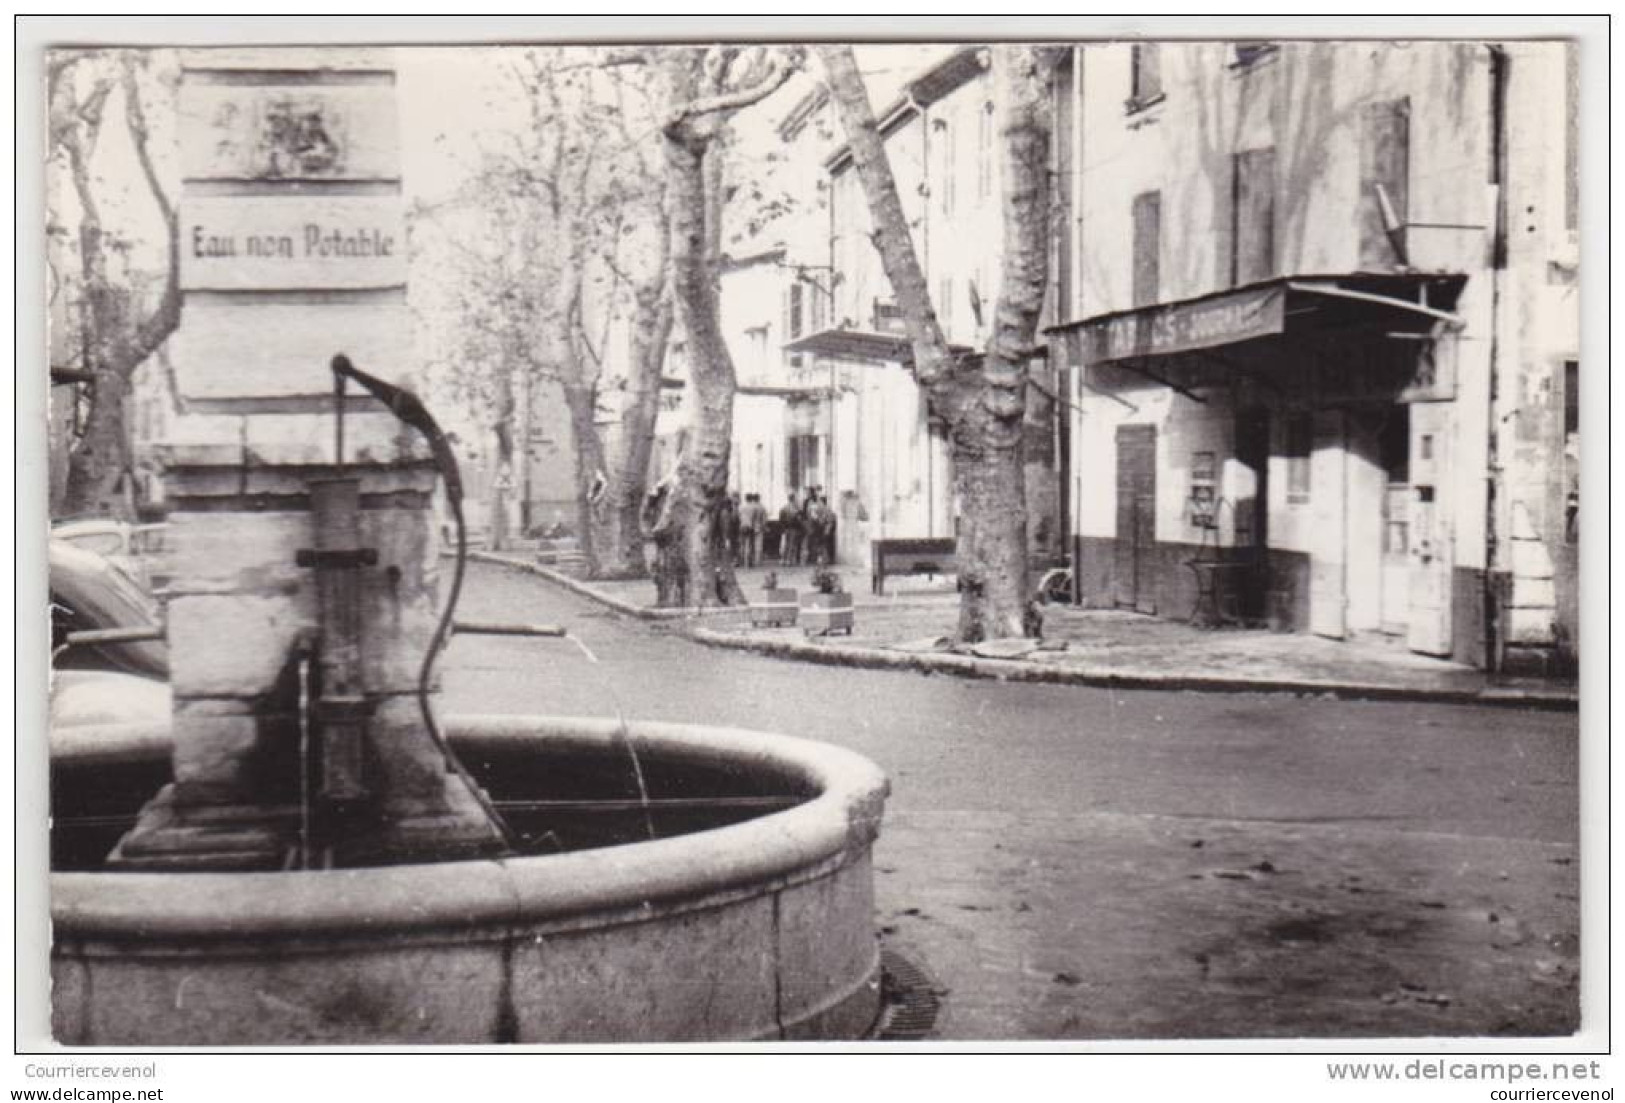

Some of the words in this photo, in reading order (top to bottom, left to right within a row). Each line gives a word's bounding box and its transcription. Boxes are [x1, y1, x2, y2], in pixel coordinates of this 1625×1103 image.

[192, 225, 237, 258] Eau
[247, 234, 294, 259] non
[304, 222, 395, 258] Potable
